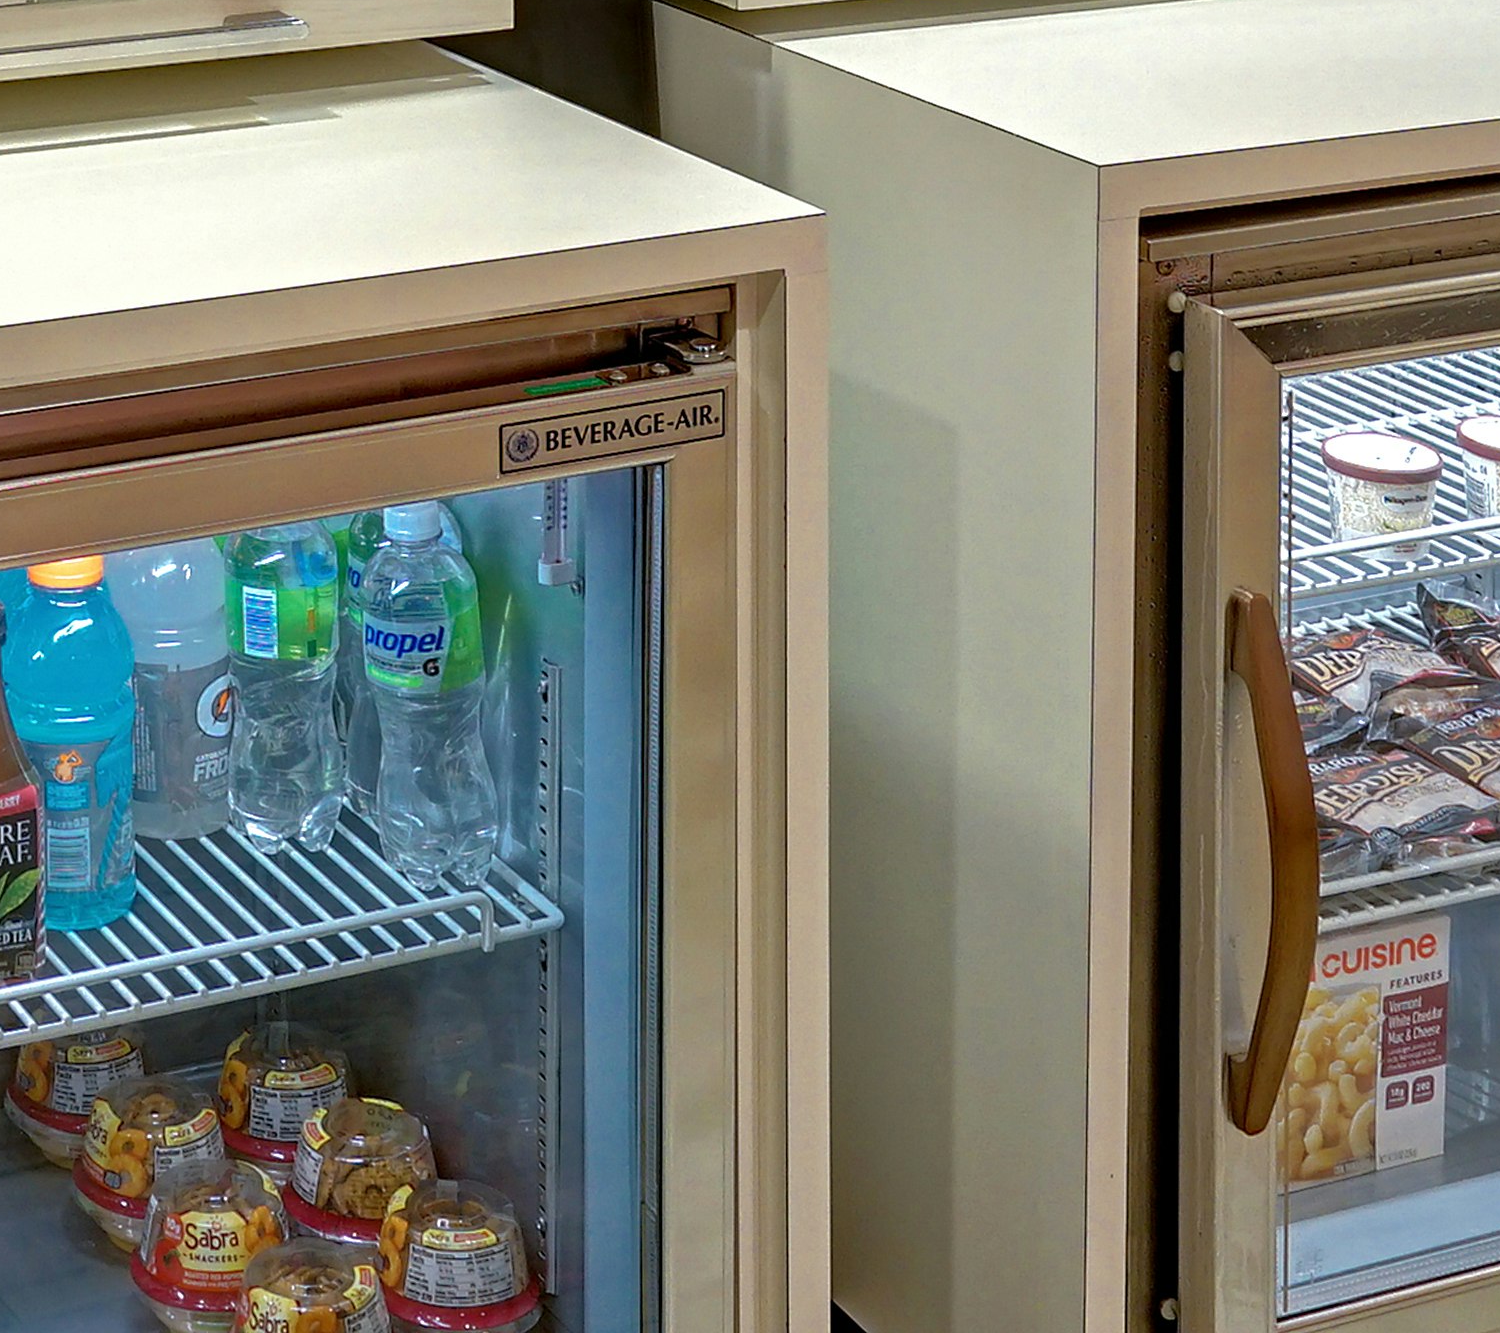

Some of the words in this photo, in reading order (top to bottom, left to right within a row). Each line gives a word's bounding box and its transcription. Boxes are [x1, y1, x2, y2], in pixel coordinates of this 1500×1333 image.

[364, 624, 446, 660] propel
[11, 928, 33, 946] TEA
[1389, 969, 1444, 990] FEATURES
[1387, 1014, 1411, 1029] White
[1411, 1007, 1444, 1025] Cheddar
[1412, 1024, 1442, 1040] Cheese
[184, 1221, 240, 1252] Sabra
[188, 1253, 239, 1264] SNACKERS
